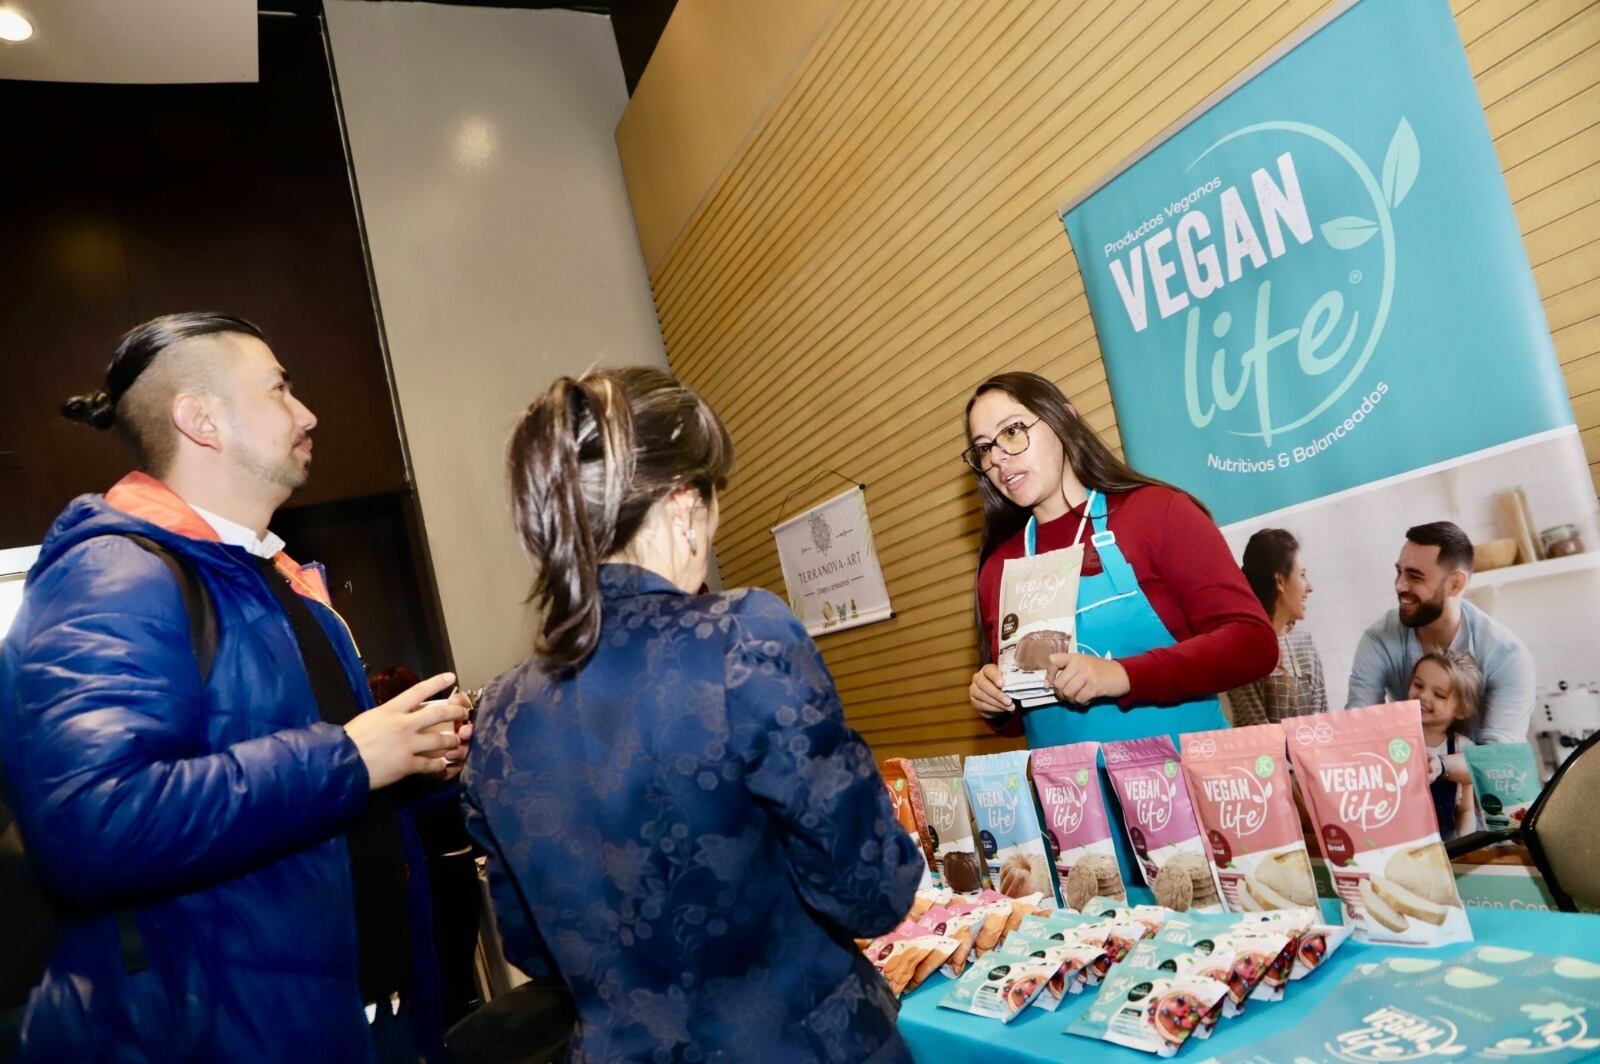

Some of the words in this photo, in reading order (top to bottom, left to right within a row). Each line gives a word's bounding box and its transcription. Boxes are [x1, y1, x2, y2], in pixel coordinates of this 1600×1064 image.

[1104, 213, 1164, 258] Productos
[1163, 176, 1222, 217] Veganos
[1109, 151, 1314, 333] VEGAN
[1184, 280, 1360, 448] life
[1207, 453, 1275, 473] Nutritivos
[1277, 452, 1290, 468] &
[1292, 381, 1389, 464] Balanceados
[1124, 779, 1160, 801] VEGAN
[1202, 778, 1251, 802] VEGAN
[1320, 765, 1384, 793] VEGAN
[926, 791, 949, 807] VEGAN
[976, 790, 1005, 808] VEGAN
[1045, 786, 1076, 805] VEGAN
[988, 807, 1012, 834] life
[1053, 804, 1079, 836] life
[1136, 800, 1167, 833] life
[1220, 801, 1261, 839] life
[1339, 791, 1392, 833] life
